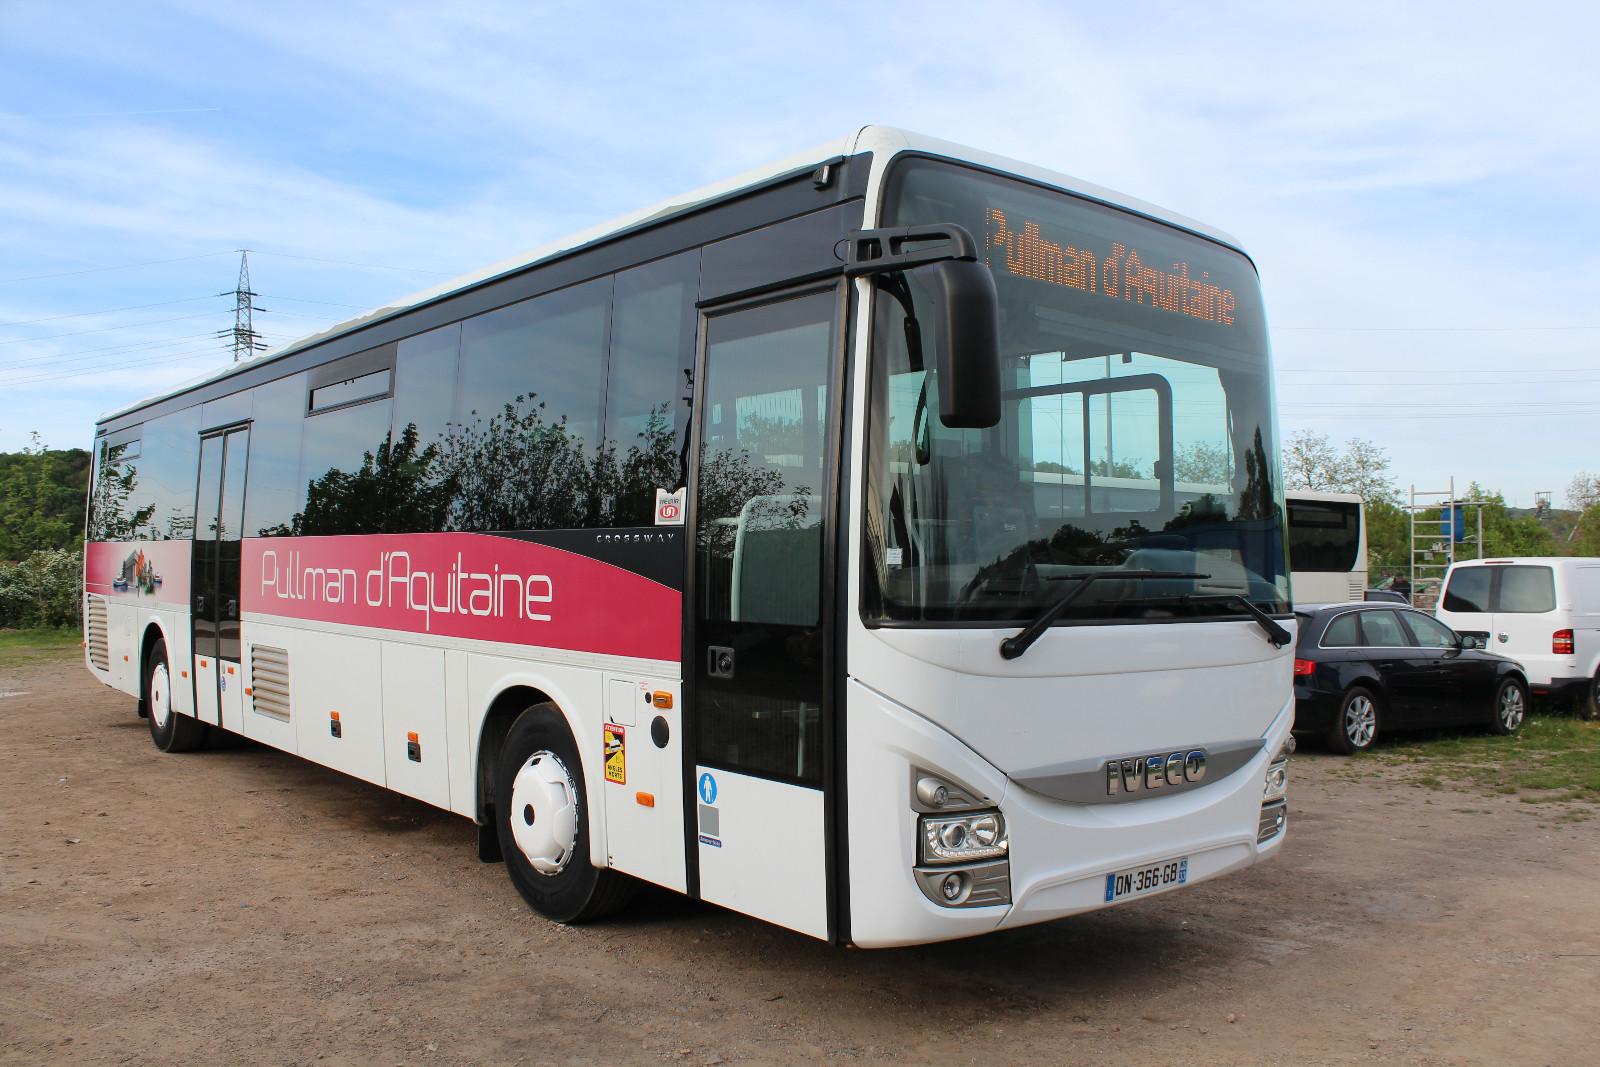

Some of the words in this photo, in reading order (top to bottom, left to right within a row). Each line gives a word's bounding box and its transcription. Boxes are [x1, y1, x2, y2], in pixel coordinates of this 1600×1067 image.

[984, 207, 1096, 293] Pullman
[1103, 241, 1235, 325] d'Aquitaine
[596, 533, 674, 543] CROSSWAY
[261, 550, 357, 605] Pullman
[366, 551, 553, 631] d'Aquitaine
[1107, 750, 1207, 795] IVECO
[1115, 862, 1178, 896] DN-366-GB
